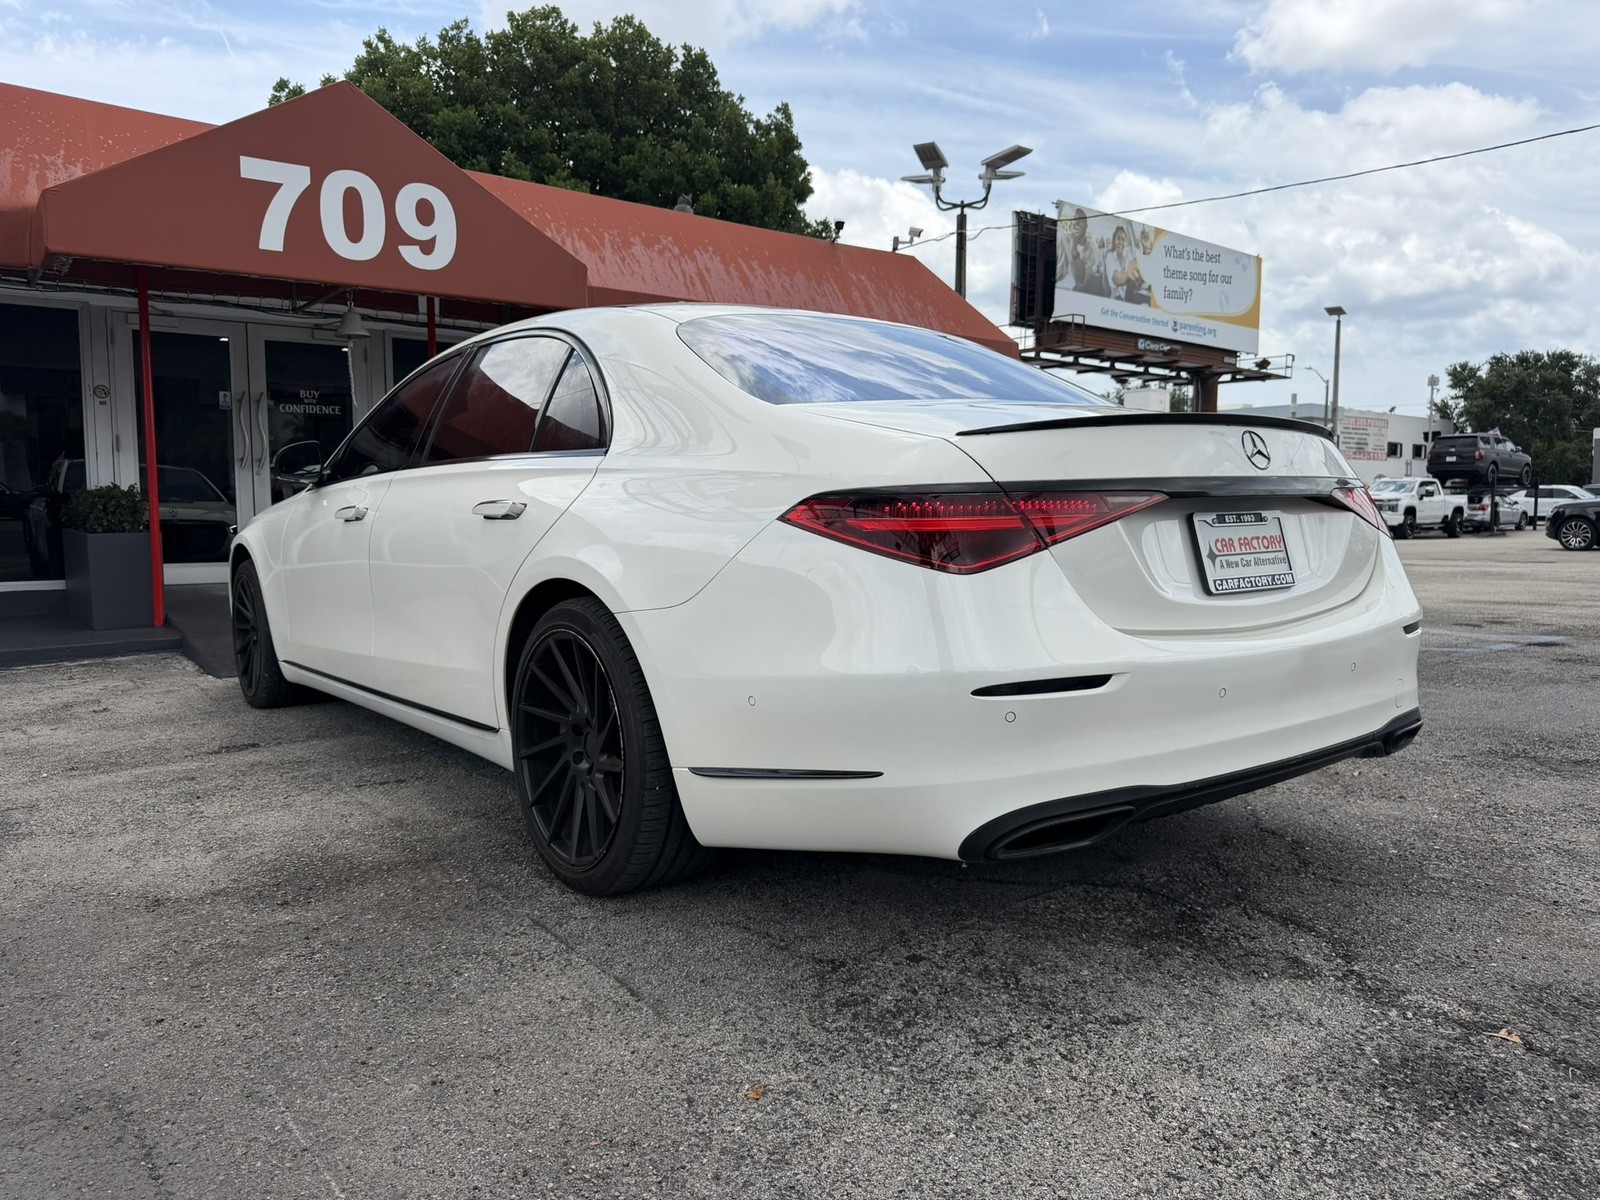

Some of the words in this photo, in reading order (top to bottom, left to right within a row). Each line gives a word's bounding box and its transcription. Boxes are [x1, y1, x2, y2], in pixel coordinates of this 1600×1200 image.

[239, 155, 457, 271] 709
[1163, 245, 1191, 261] What's
[1192, 248, 1204, 262] the
[1205, 250, 1221, 264] best
[1163, 265, 1188, 280] theme
[1189, 271, 1207, 286] song
[1208, 270, 1219, 283] for
[1219, 275, 1233, 285] our
[1163, 286, 1192, 304] family?
[1100, 307, 1110, 316] Get
[1110, 309, 1119, 318] the
[1119, 311, 1151, 323] Conversation
[1179, 322, 1217, 338] parenting.org
[300, 389, 320, 399] BUY
[279, 403, 341, 415] CONFIDENCE
[1225, 515, 1239, 523] EST.
[1215, 539, 1236, 553] CAR
[1238, 535, 1282, 551] FACTORY
[1220, 560, 1225, 569] A
[1226, 560, 1240, 569] New
[1241, 558, 1252, 567] Car
[1253, 555, 1287, 567] Alternative
[1215, 574, 1293, 590] CARFACTORY.COM
